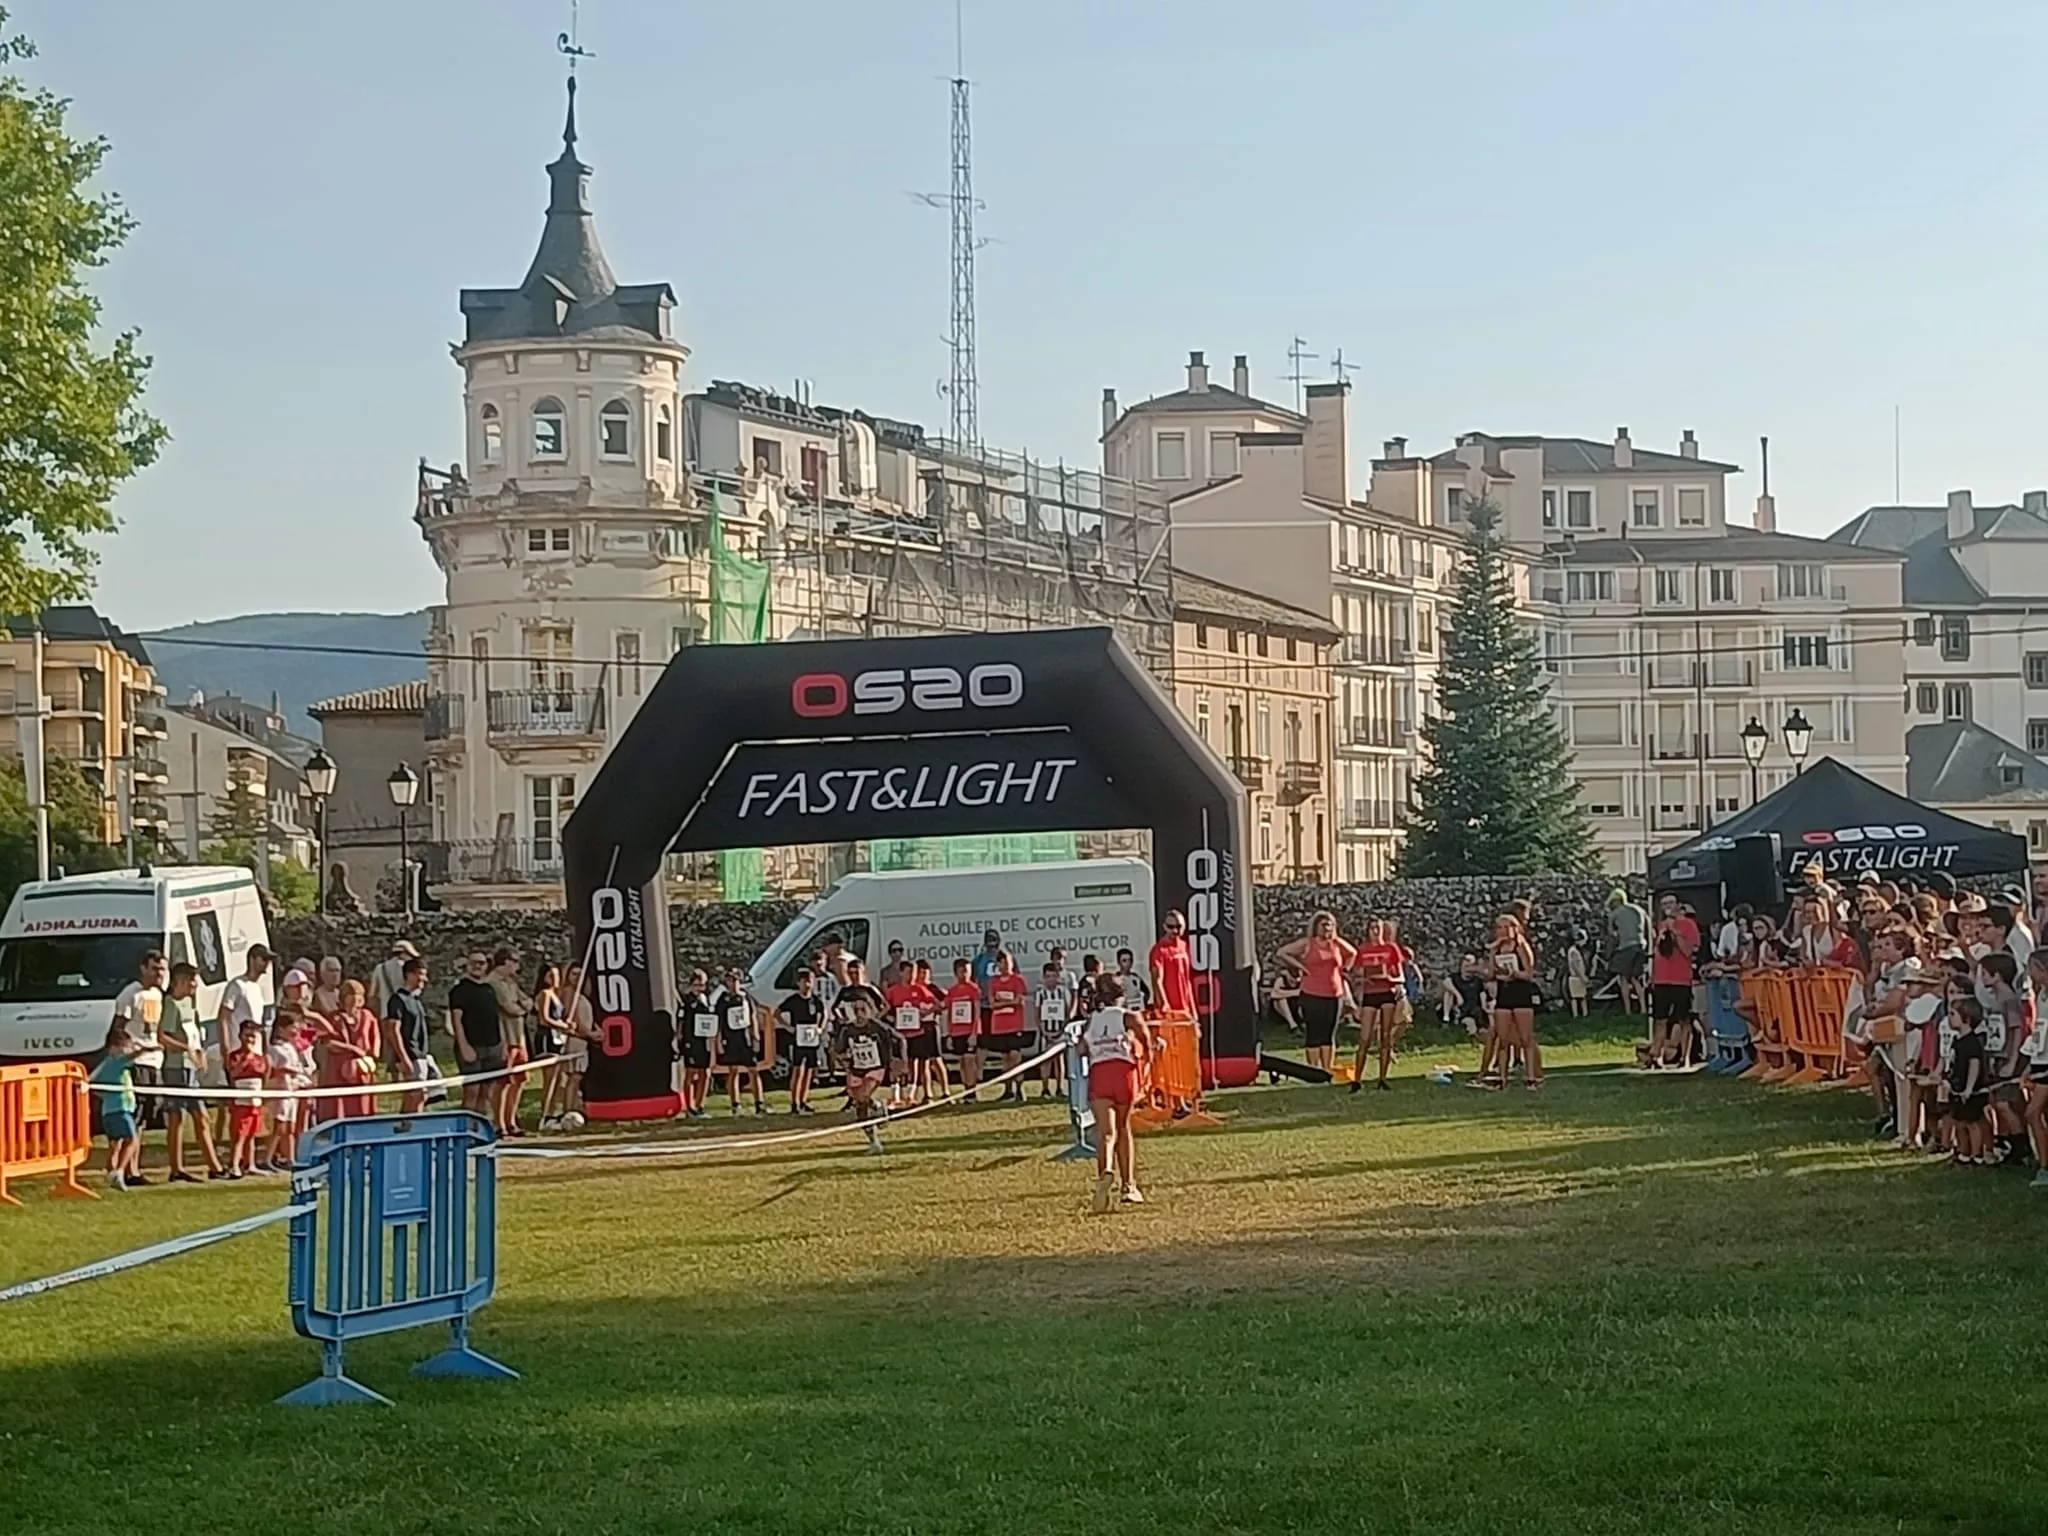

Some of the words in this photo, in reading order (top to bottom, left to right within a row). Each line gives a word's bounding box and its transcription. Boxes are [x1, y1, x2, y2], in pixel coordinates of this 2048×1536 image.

[738, 759, 1077, 818] FAST&LIGHT
[1789, 845, 1960, 874] FAST&LIGHT
[627, 886, 646, 970] FAST&LIGHT
[1000, 918, 1019, 933] DE
[1026, 914, 1085, 931] COCHES
[1091, 913, 1100, 927] Y
[23, 1037, 75, 1050] IVECO
